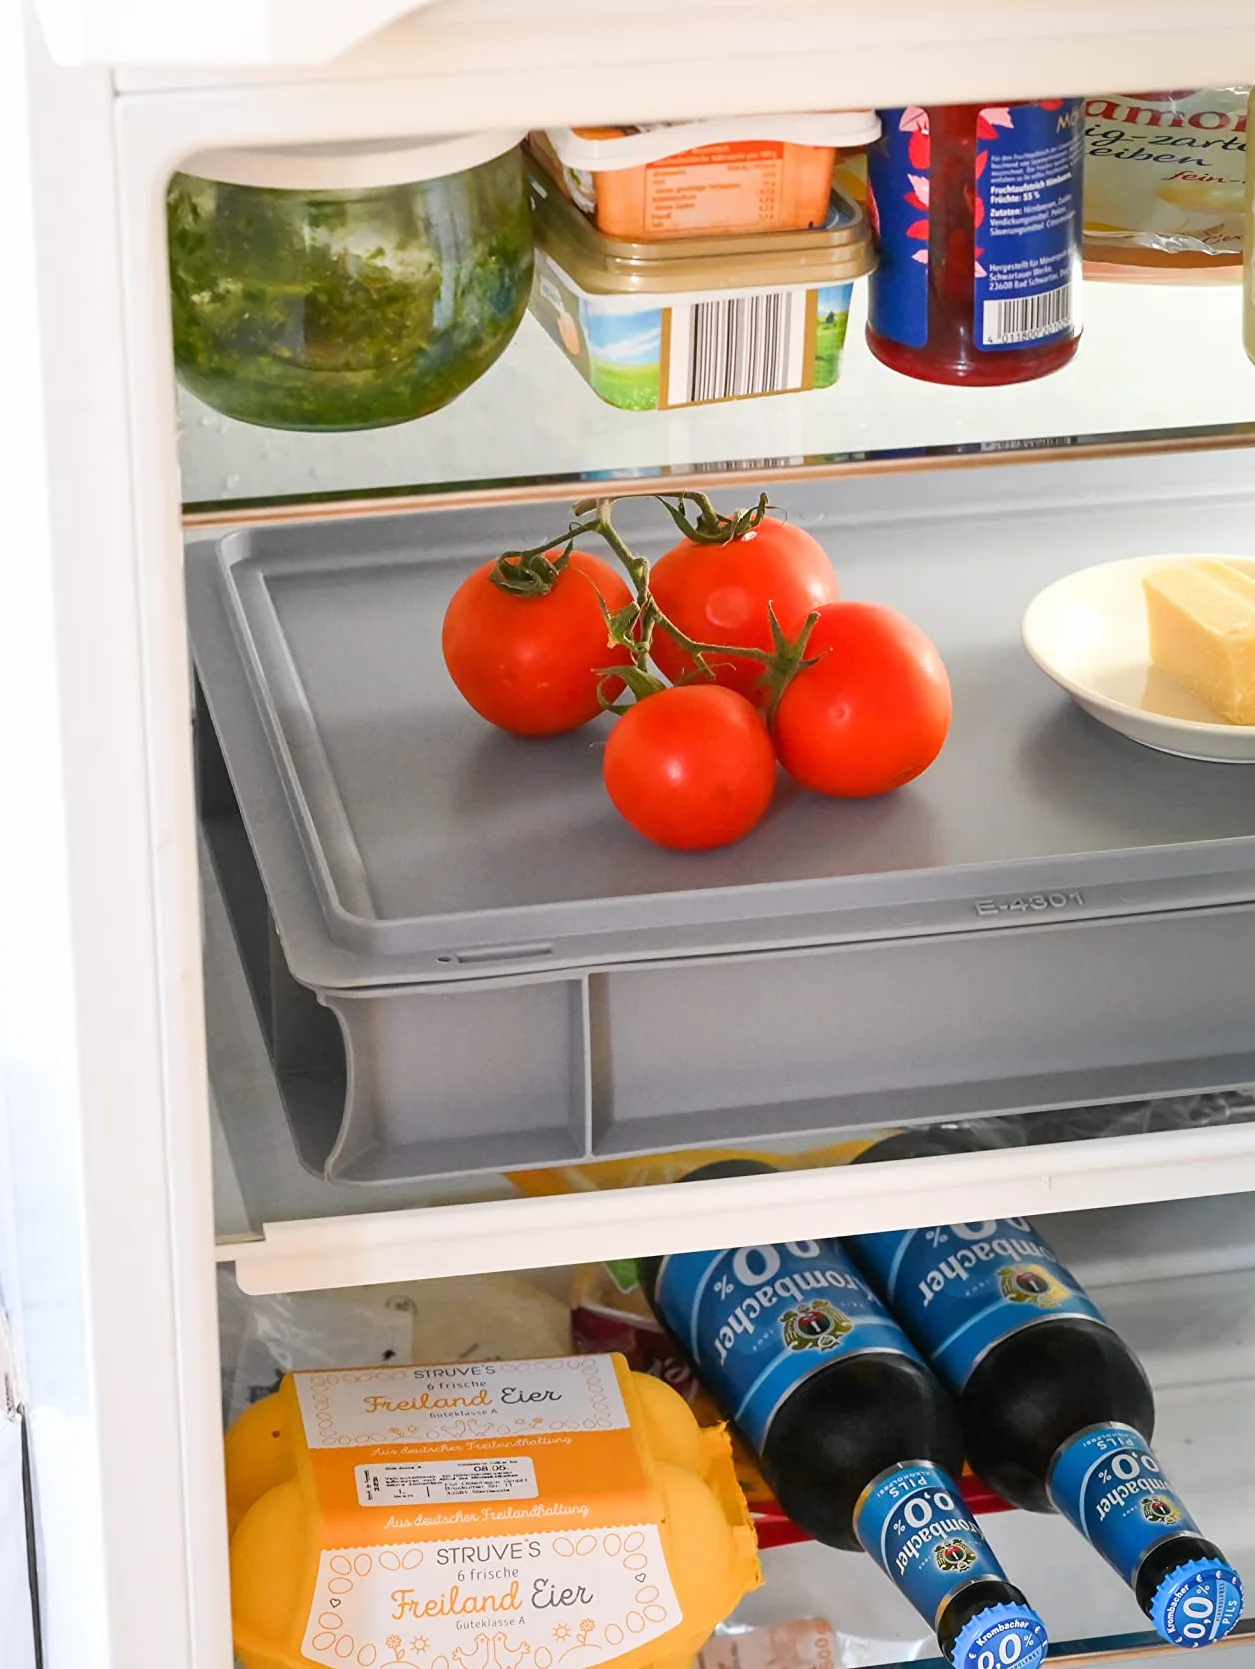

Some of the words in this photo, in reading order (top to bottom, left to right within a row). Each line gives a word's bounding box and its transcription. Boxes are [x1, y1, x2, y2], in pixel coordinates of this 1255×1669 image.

[1085, 147, 1213, 166] eiben
[1162, 170, 1246, 184] fein-
[974, 891, 1086, 917] E-4301
[918, 1238, 1059, 1308] ombacher
[439, 1380, 488, 1390] frische
[364, 1389, 493, 1414] Freiland
[500, 1386, 563, 1404] Eier
[889, 1476, 928, 1498] PILS
[1095, 1478, 1169, 1522] mbacher
[383, 1516, 412, 1530] Aus
[414, 1510, 479, 1528] deutscher
[480, 1503, 590, 1520] Freilandhaltung
[457, 1569, 466, 1582] 6
[470, 1566, 519, 1581] frische
[391, 1580, 523, 1620] Freiland
[531, 1577, 594, 1610] Eier
[1166, 1584, 1190, 1634] Krombacher
[1222, 1600, 1238, 1625] PILS
[975, 1618, 1029, 1647] Krombacher
